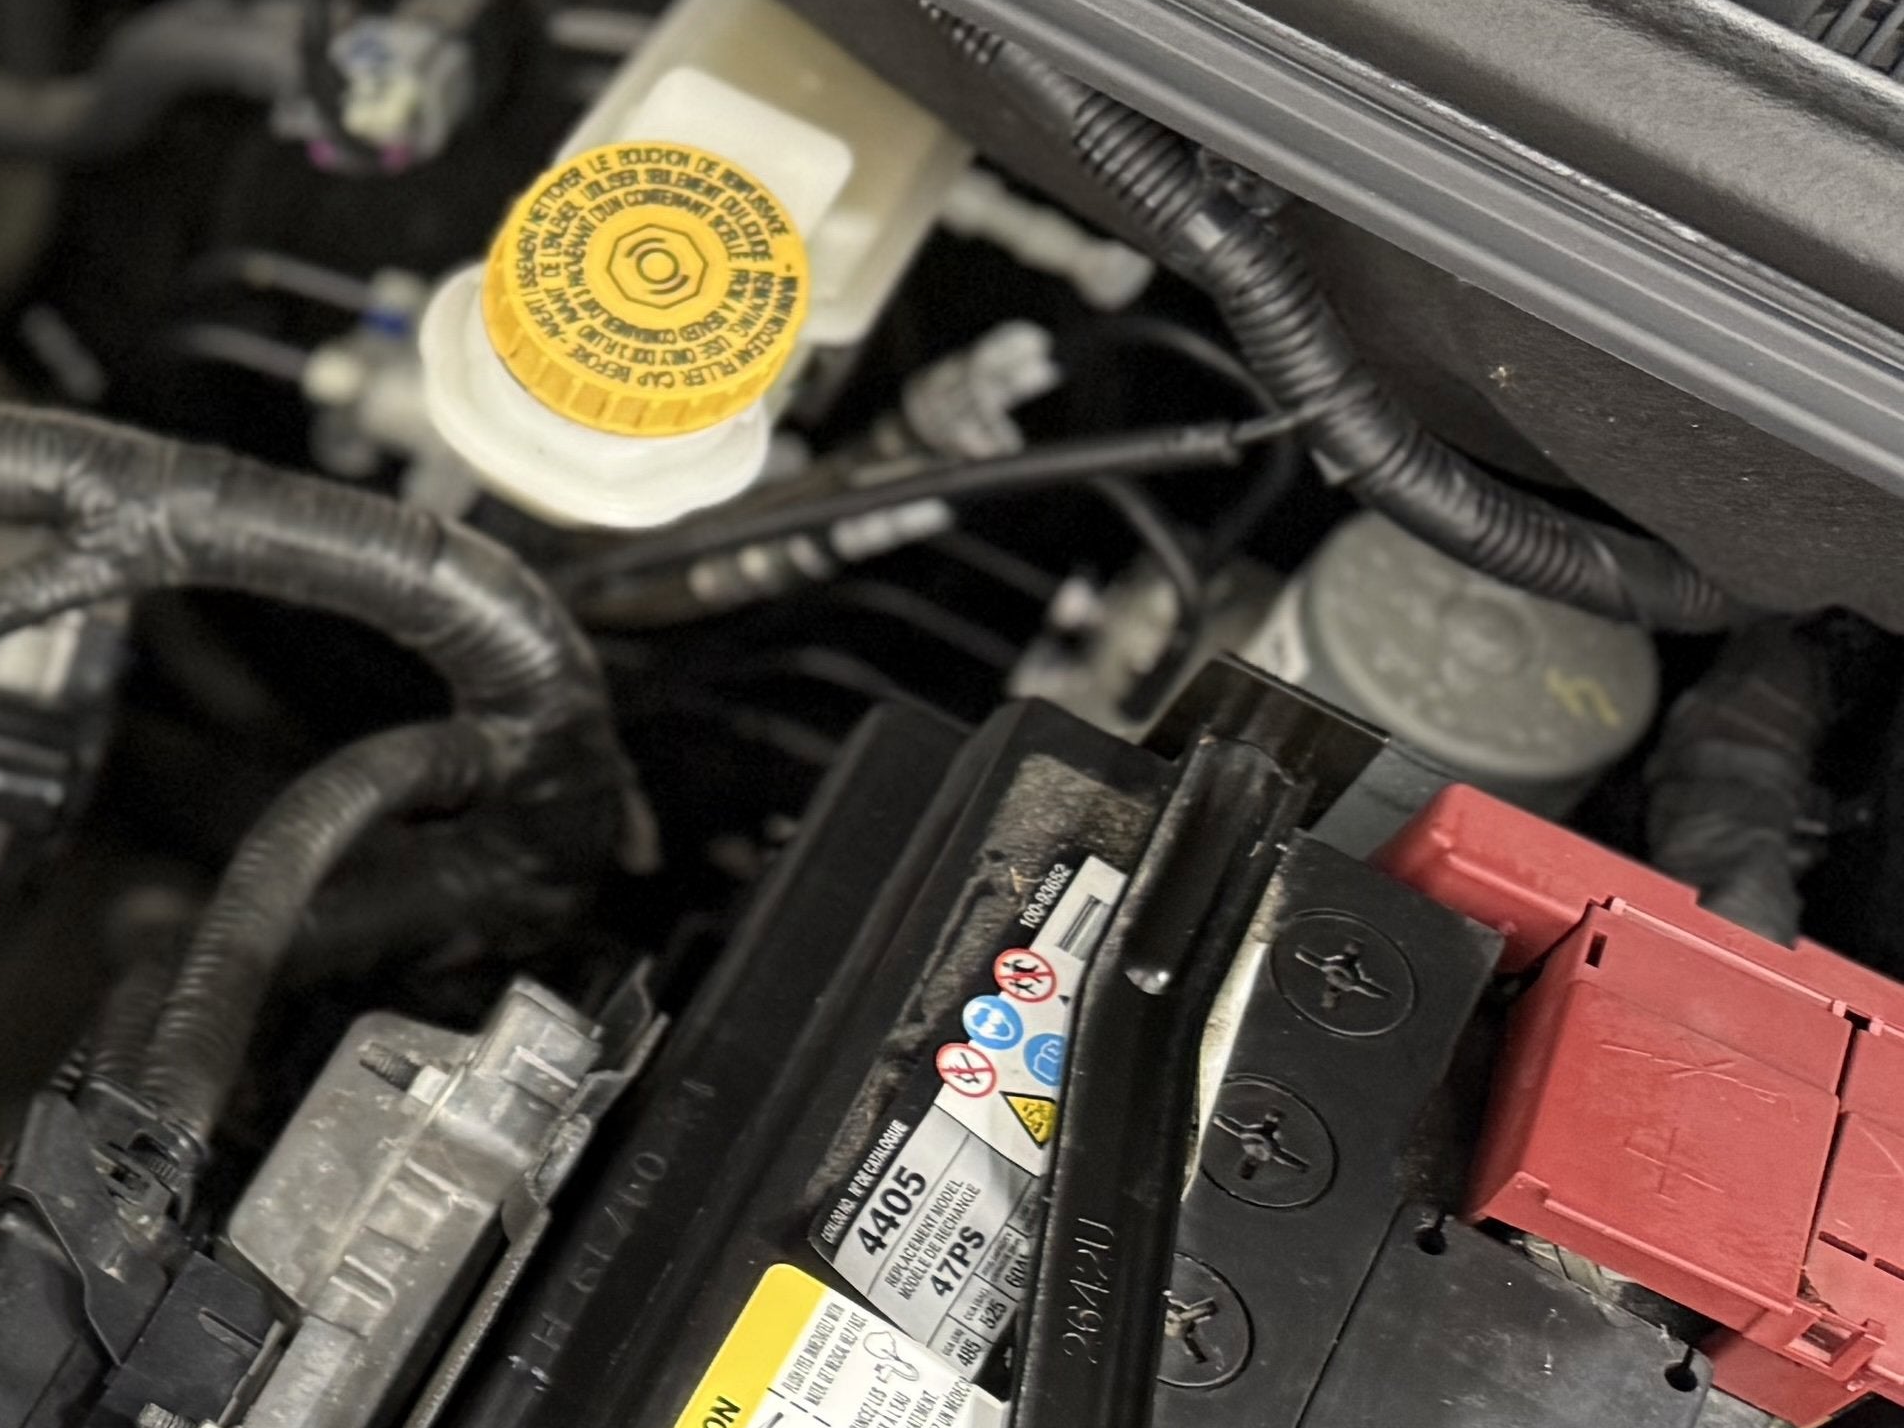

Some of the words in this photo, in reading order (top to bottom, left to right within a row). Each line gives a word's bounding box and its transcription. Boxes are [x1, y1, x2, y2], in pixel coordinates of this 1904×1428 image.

[520, 164, 588, 228] NETTOYER
[585, 153, 612, 176] LE
[614, 146, 693, 170] BOUCHON
[693, 156, 721, 179] DE
[577, 165, 641, 204] UTILISER
[538, 261, 562, 278] DE
[542, 283, 585, 331] AVANT
[715, 299, 740, 318] A
[562, 341, 632, 384] BEFORE
[694, 331, 734, 362] USE
[634, 369, 676, 389] CAP
[678, 353, 741, 391] FILLER
[1017, 861, 1075, 930] 100-93652
[861, 1116, 910, 1176] CATALOGUE
[853, 1168, 875, 1188] DE
[849, 1161, 931, 1260] 4405
[882, 1212, 940, 1289] REPLACEMENT
[929, 1175, 965, 1217] MODEL
[893, 1255, 932, 1301] MODÈLE
[922, 1241, 942, 1260] DE
[932, 1181, 982, 1245] RECHANGE
[924, 1222, 988, 1301] 47PS
[977, 1296, 1010, 1331] 525
[952, 1336, 984, 1369] 485
[863, 1384, 889, 1408] LES
[931, 1406, 957, 1428] UN
